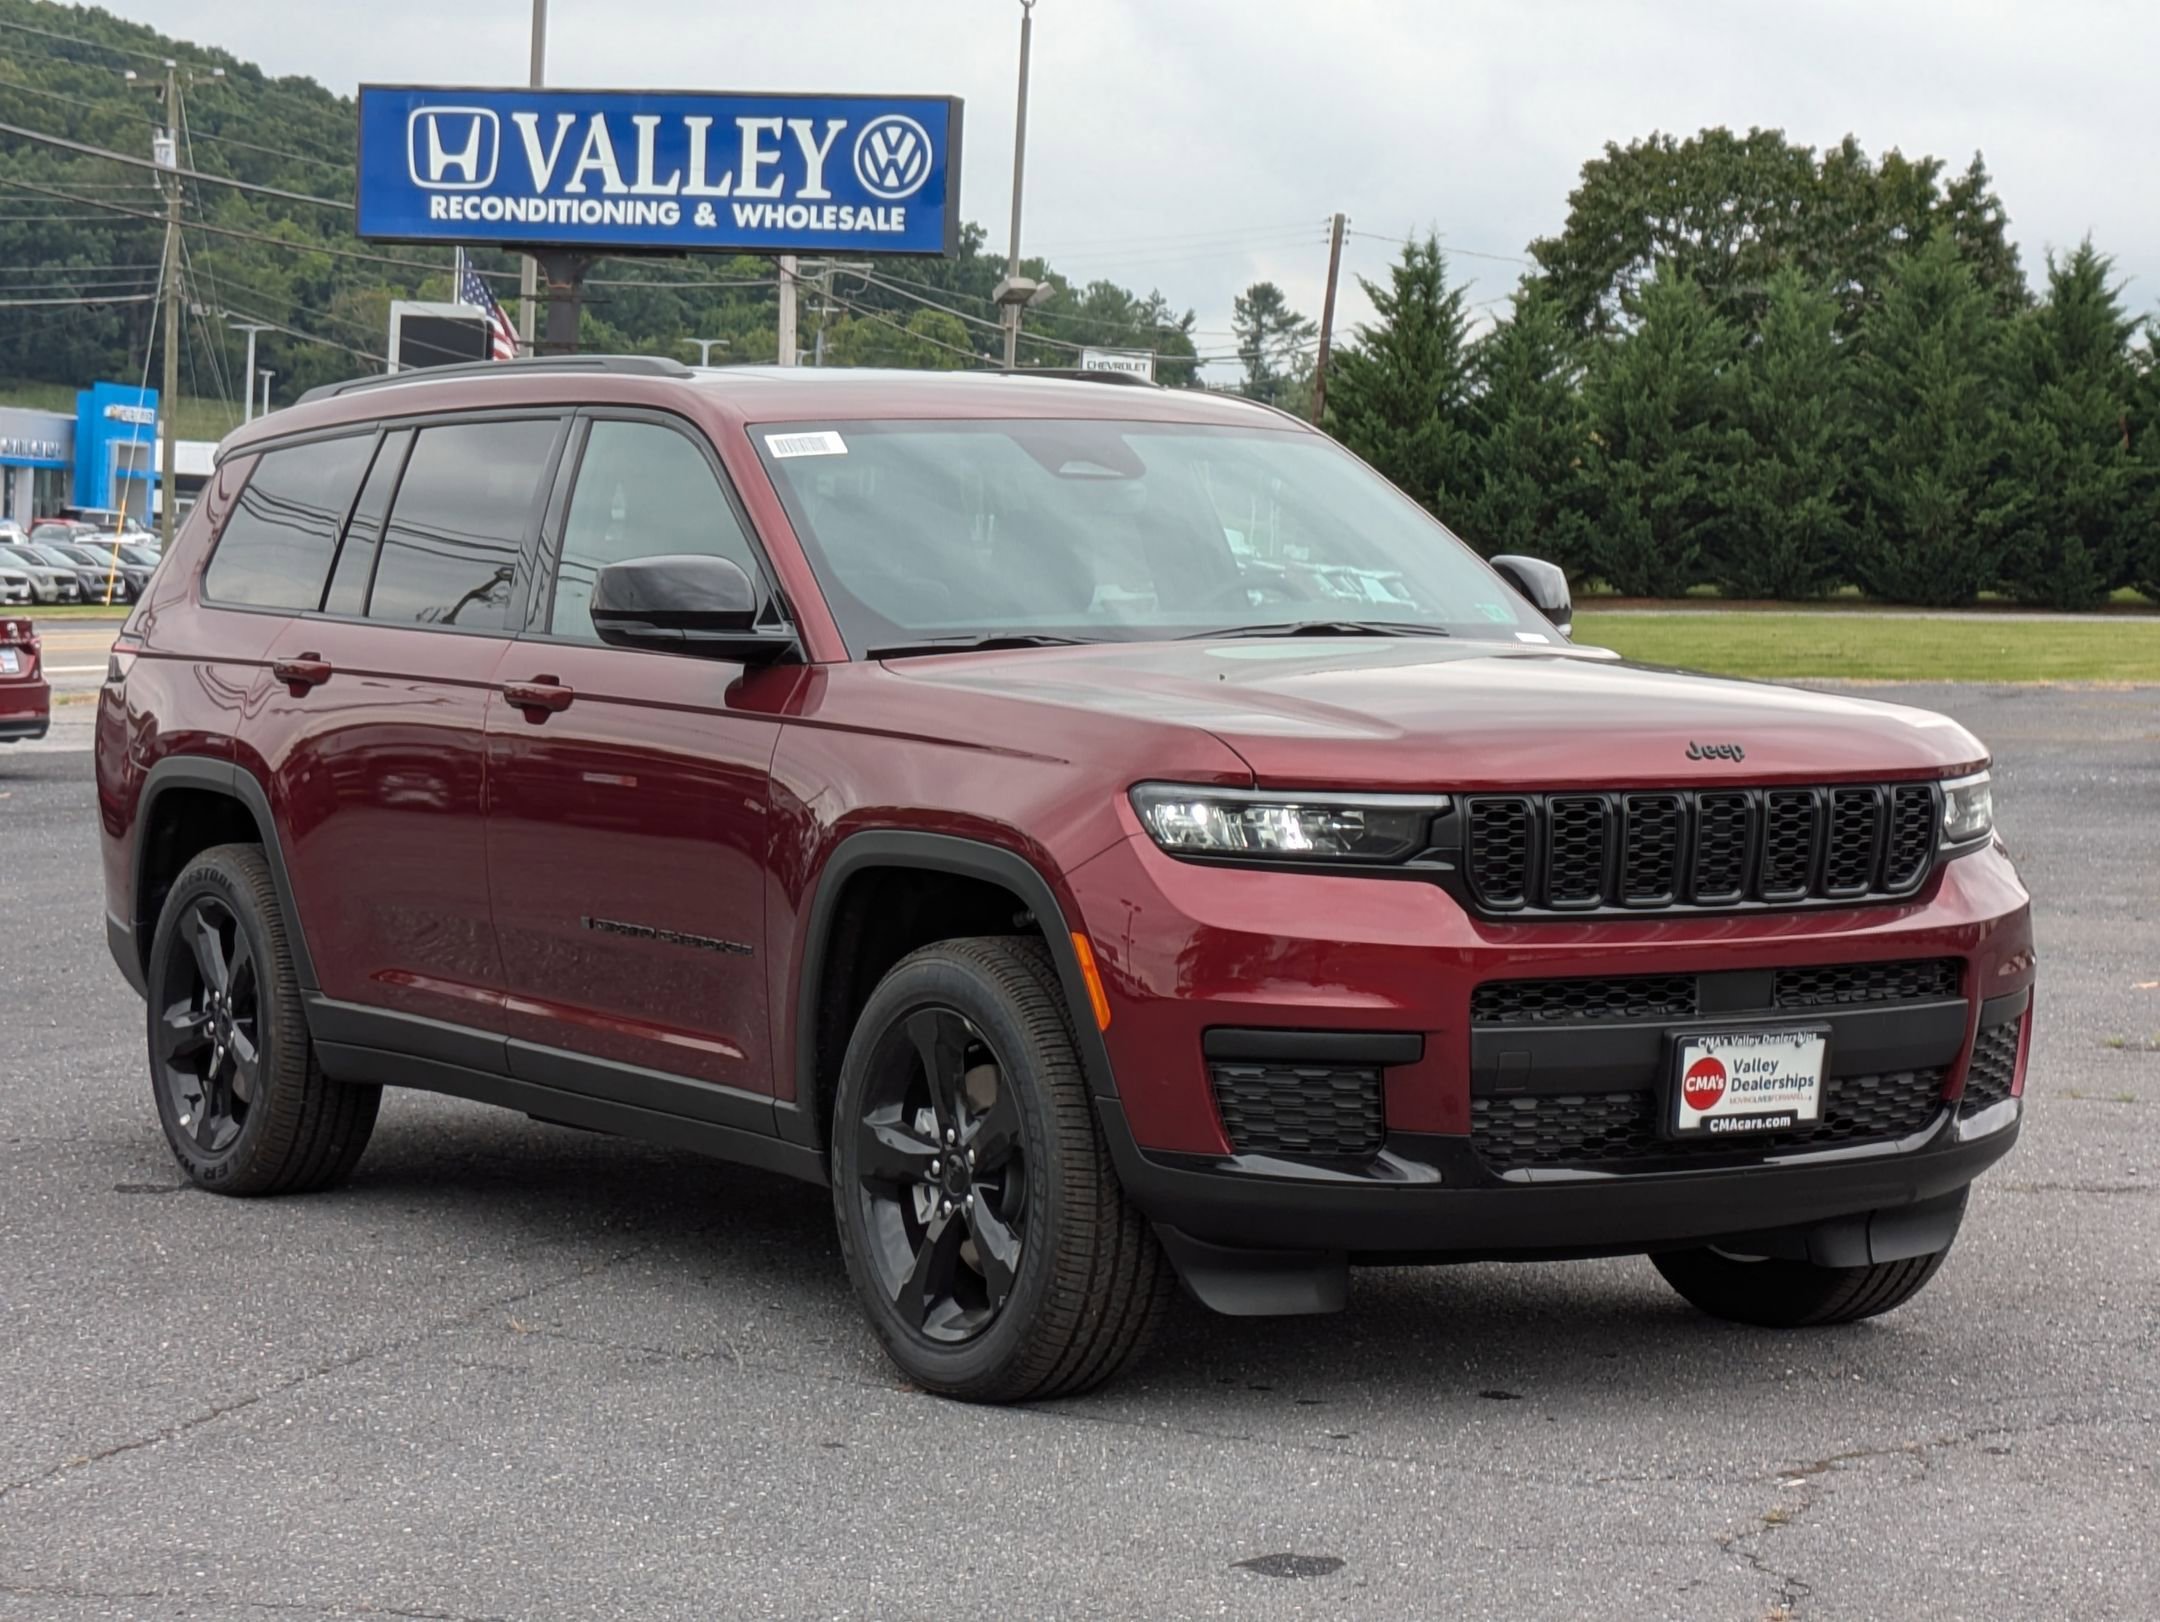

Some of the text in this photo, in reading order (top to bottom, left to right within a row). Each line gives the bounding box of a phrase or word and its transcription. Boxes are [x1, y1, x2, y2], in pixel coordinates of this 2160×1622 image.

[512, 111, 848, 199] VALLEY
[430, 195, 906, 232] RECONDITIONING & WHOLESALE
[1086, 360, 1147, 372] CHEVROLET
[1685, 740, 1746, 763] Jeep
[1733, 1057, 1779, 1076] Valley
[1685, 1074, 1725, 1093] CMA's
[1731, 1073, 1814, 1093] Dealerships
[1710, 1117, 1791, 1132] CMAcars.com
